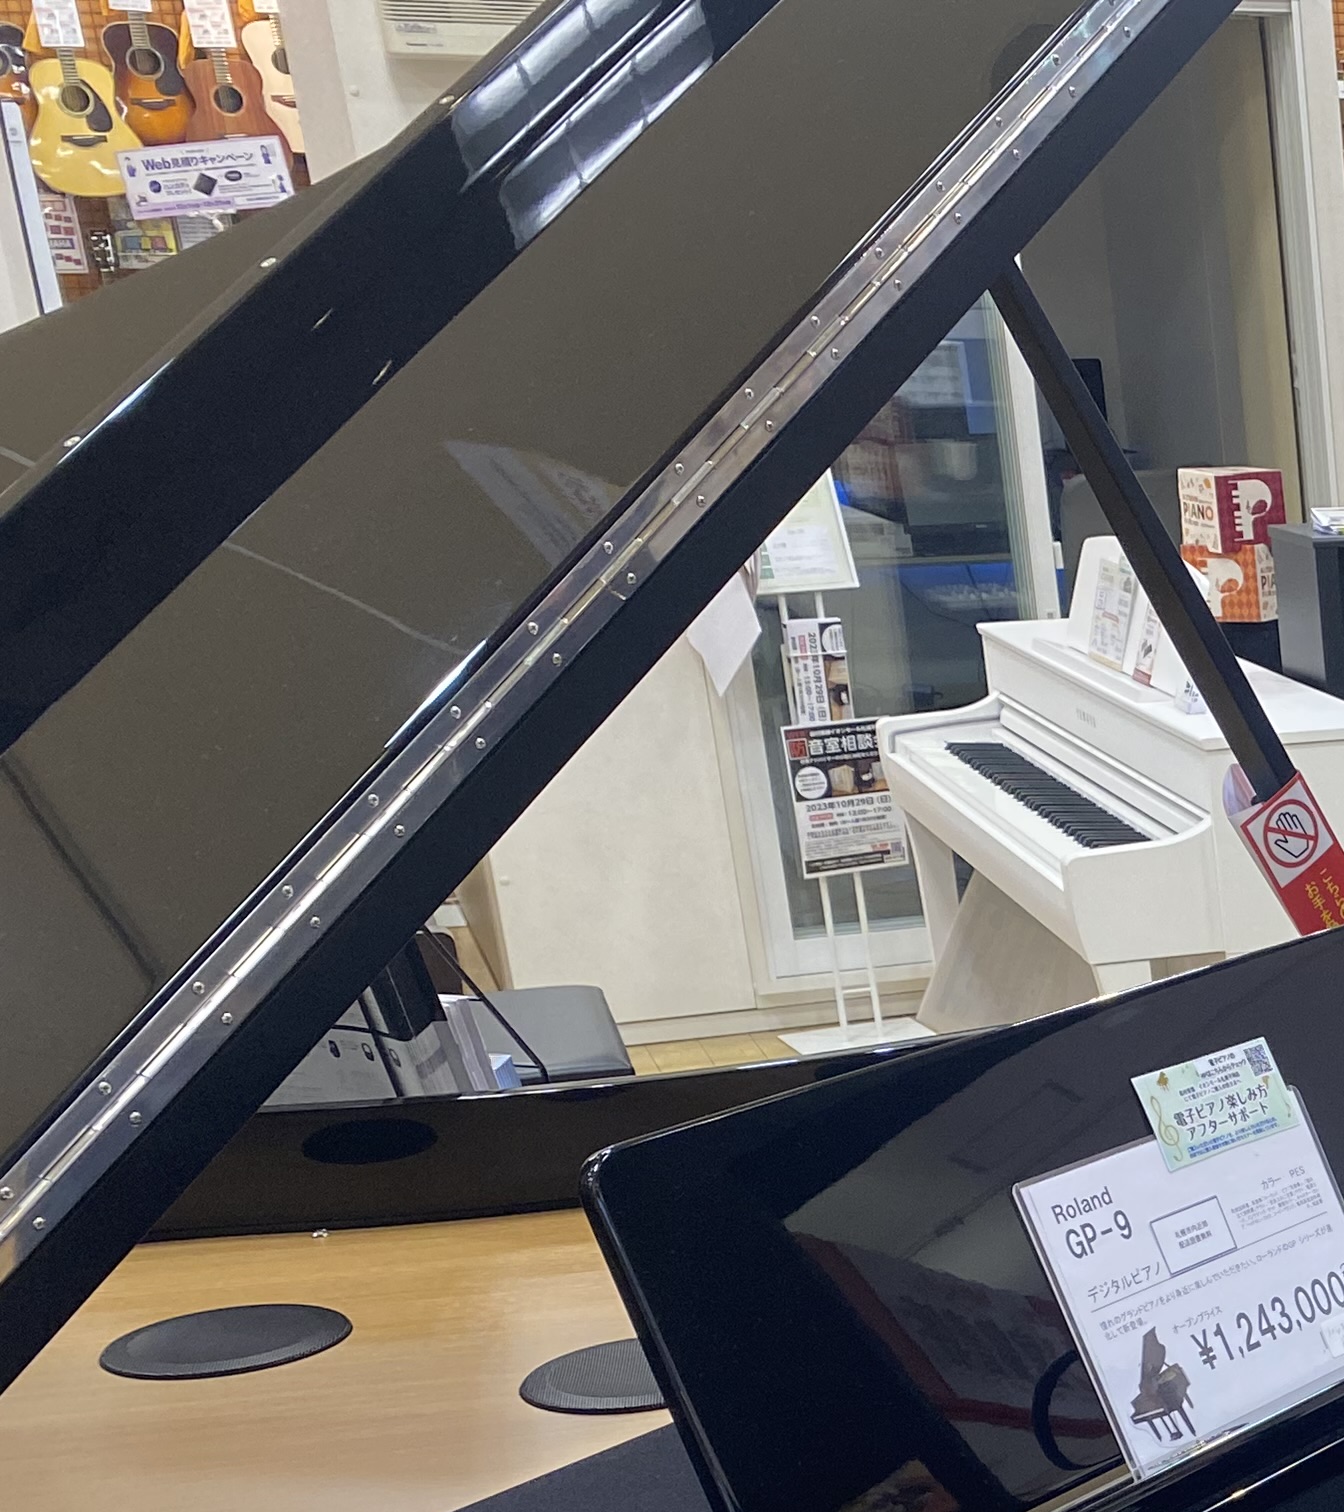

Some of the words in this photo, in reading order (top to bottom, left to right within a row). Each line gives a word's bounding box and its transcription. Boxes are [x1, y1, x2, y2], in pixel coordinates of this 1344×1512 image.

[1183, 501, 1214, 521] PIANO
[1171, 1082, 1269, 1128] 電子ピアノ楽しみ方
[1184, 1100, 1270, 1141] アフターサポート
[1259, 1173, 1283, 1190] カラー
[1288, 1164, 1306, 1179] PES
[1049, 1185, 1114, 1225] Roland
[1060, 1207, 1136, 1261] GP-9
[1084, 1260, 1165, 1305] デジタルピアノ
[1170, 1304, 1223, 1335] オープンプライス
